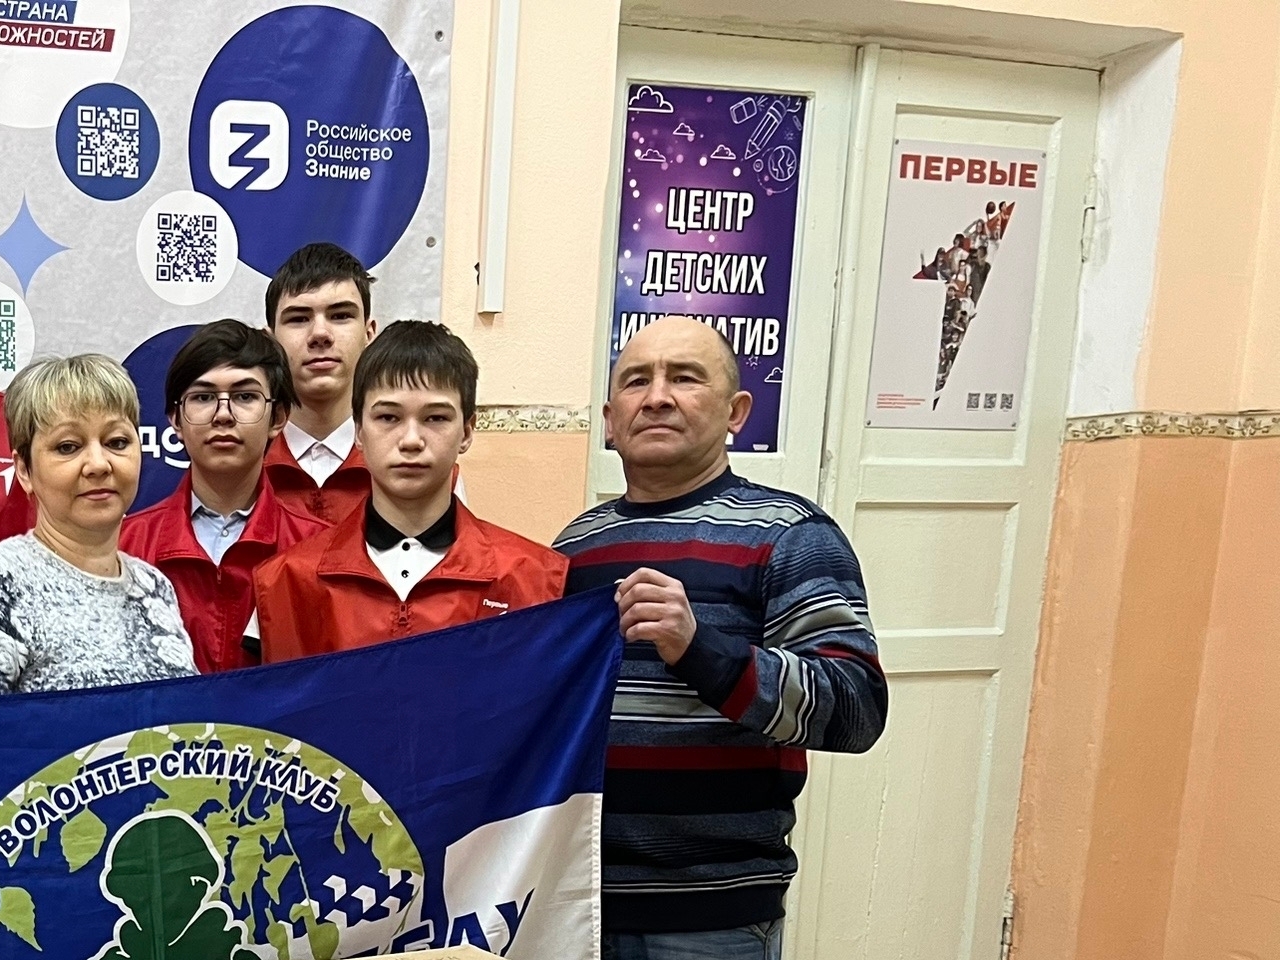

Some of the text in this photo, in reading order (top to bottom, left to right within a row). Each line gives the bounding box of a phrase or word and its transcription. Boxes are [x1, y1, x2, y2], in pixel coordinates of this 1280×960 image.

[306, 119, 412, 142] Российское
[306, 140, 393, 161] общество
[305, 159, 371, 180] Знание
[899, 154, 1039, 189] ПЕРВЫЕ
[667, 188, 754, 233] ЦЕНТР
[642, 251, 767, 295] ДЕТСКИХ
[259, 759, 339, 811] КЛУБ
